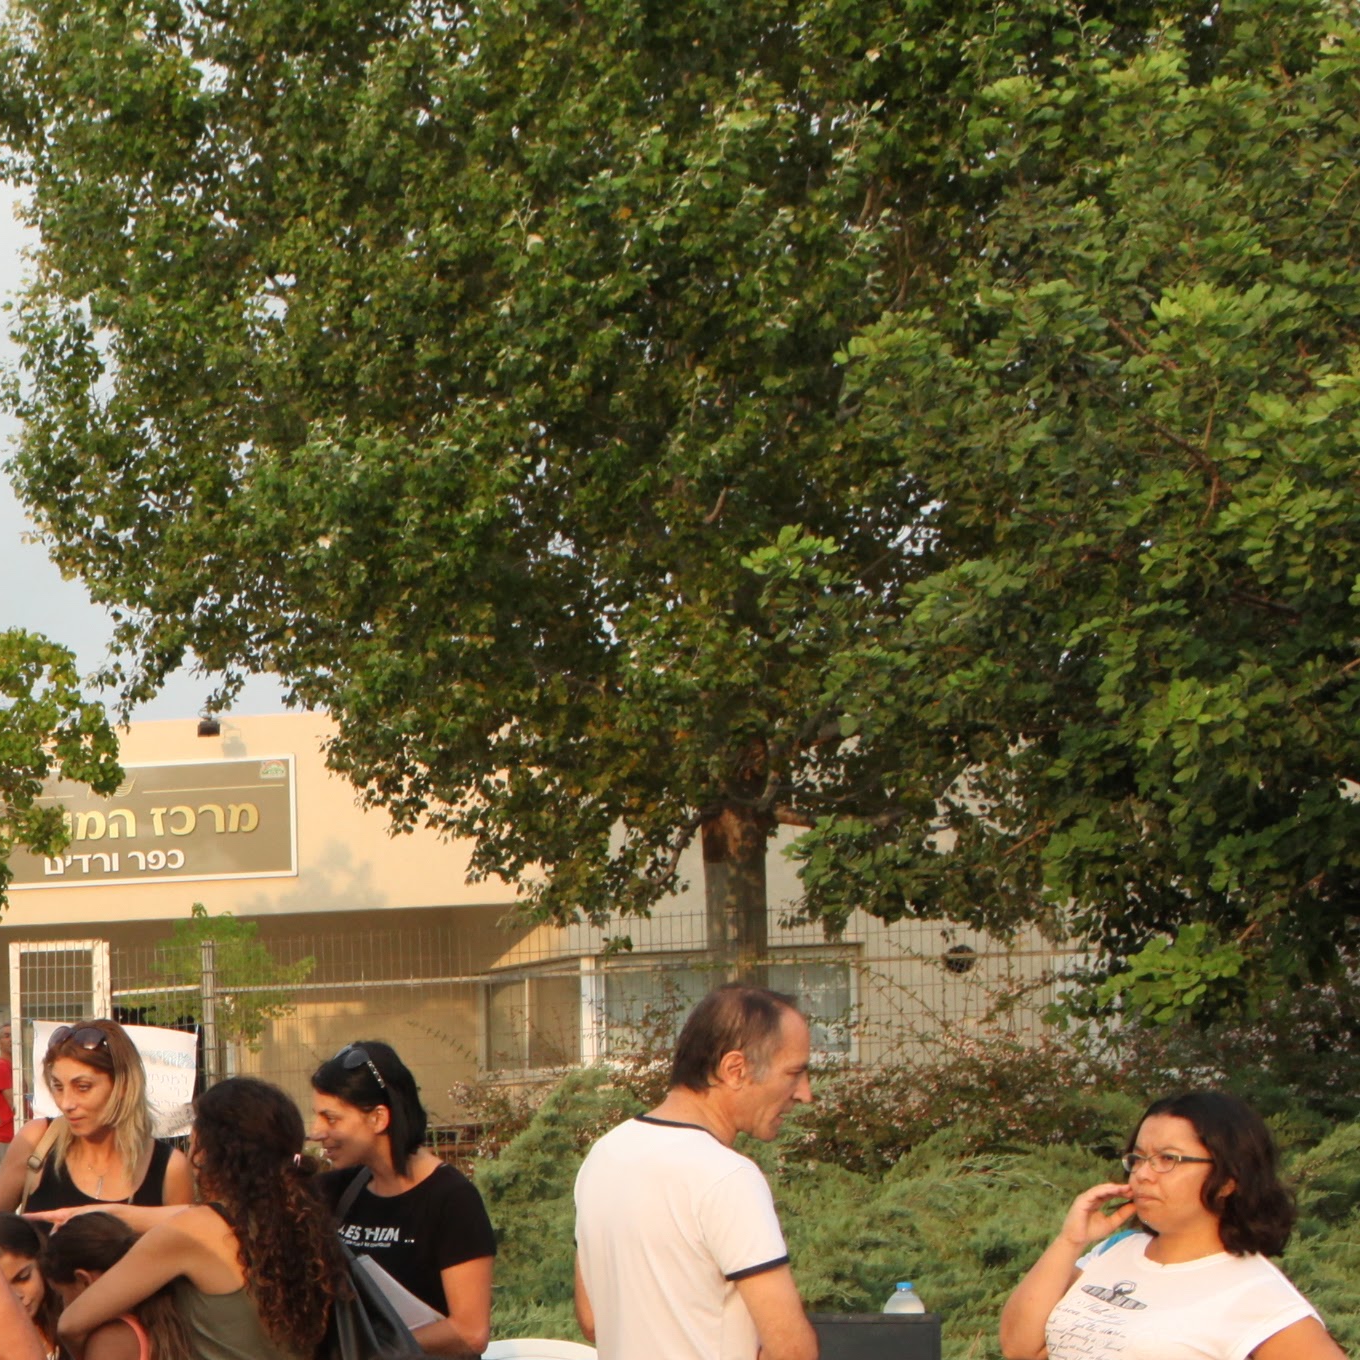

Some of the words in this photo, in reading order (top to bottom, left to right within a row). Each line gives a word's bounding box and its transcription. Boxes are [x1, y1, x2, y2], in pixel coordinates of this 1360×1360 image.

[150, 803, 260, 836] מרכז
[44, 853, 120, 876] ורדים
[128, 849, 185, 871] כפר
